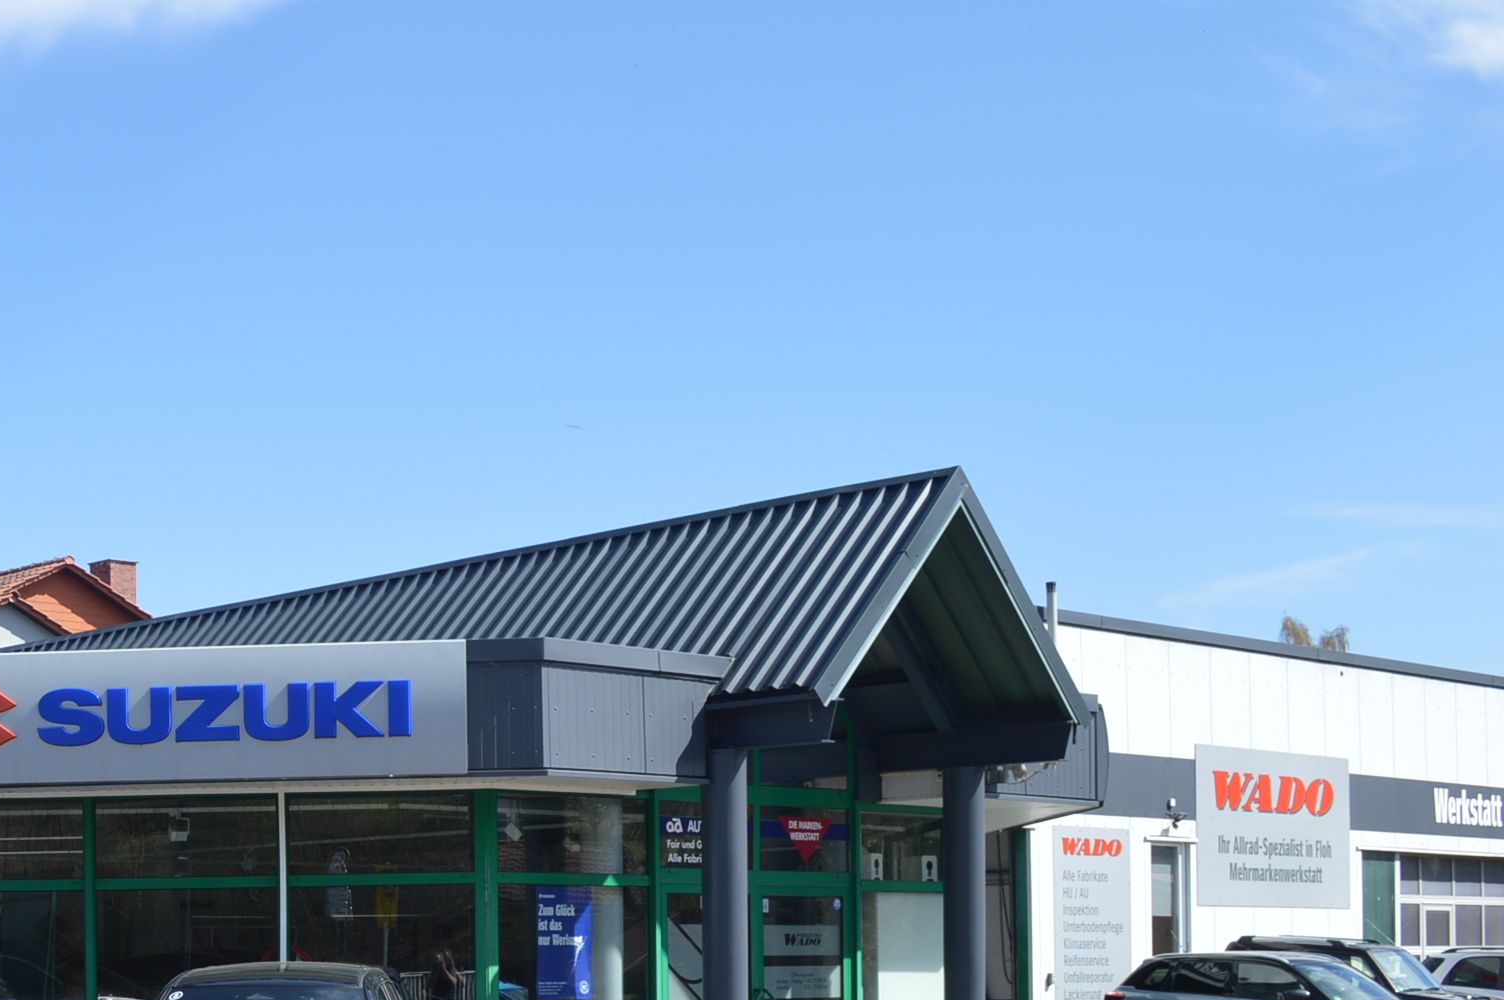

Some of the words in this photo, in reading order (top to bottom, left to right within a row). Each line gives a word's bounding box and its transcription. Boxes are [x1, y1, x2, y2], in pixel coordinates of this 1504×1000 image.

[36, 679, 413, 747] SUZUKI
[1212, 770, 1334, 817] WADO
[1433, 787, 1502, 828] Werkstatt
[788, 820, 799, 830] DIE
[790, 832, 820, 841] WERKSTATT
[666, 840, 681, 850] Fair
[682, 839, 695, 849] und
[1062, 837, 1123, 857] WADO
[1218, 835, 1230, 854] Ihr
[1233, 836, 1304, 859] Allrad-Spezialist
[1305, 840, 1313, 858] in
[1315, 840, 1332, 858] Floh
[668, 853, 683, 863] Alle
[684, 854, 702, 863] Fabri
[1062, 870, 1075, 882] Alle
[1077, 871, 1109, 883] Fabrikate
[1229, 862, 1323, 883] Mehrmarkenwerkstatt
[1062, 887, 1073, 899] HU
[1079, 888, 1089, 899] AU
[538, 904, 554, 916] Zum
[555, 904, 575, 916] Glück
[1062, 904, 1099, 917] Inspektion
[538, 918, 548, 931] ist
[549, 919, 563, 931] das
[1063, 921, 1124, 935] Unterbodenpflege
[538, 936, 551, 946] nur
[784, 933, 821, 946] WADO
[1063, 938, 1107, 950] Klimaservice
[1063, 955, 1110, 966] Reifenservice
[1064, 972, 1114, 984] Unfallreparatur
